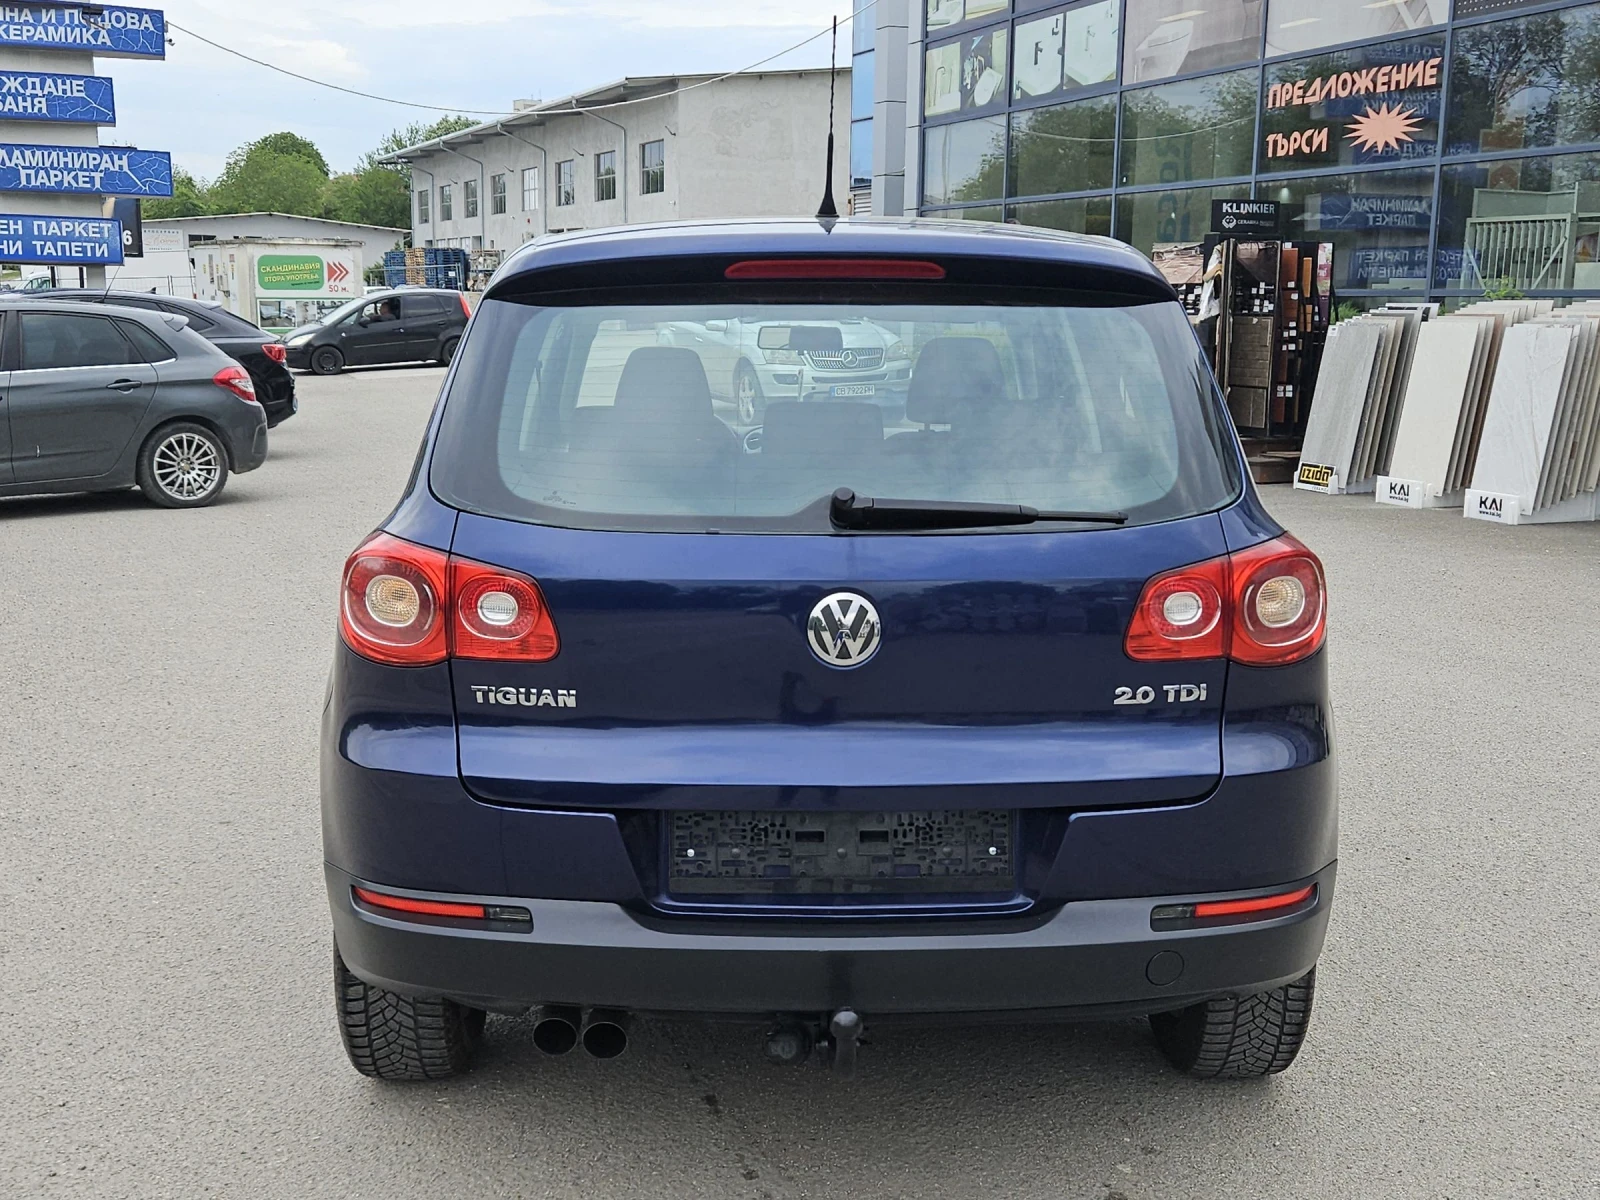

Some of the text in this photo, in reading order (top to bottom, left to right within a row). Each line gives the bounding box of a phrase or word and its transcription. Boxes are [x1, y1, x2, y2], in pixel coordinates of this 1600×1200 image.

[42, 9, 56, 23] И
[0, 76, 85, 97] ЖДАНЕ
[1268, 57, 1442, 109] ПРЕДЛОЖЕНИЕ
[0, 96, 47, 113] АНЯ
[1266, 127, 1328, 158] ТЪРСИ
[21, 170, 104, 188] ПАРКЕТ
[1222, 202, 1275, 214] KLINKIER
[33, 221, 112, 238] ПАРКЕТ
[123, 230, 133, 246] 6
[32, 241, 108, 258] ТАПЕТИ
[260, 262, 321, 273] СКАНДИНАВИЯ
[264, 275, 286, 283] ВТОРА
[328, 284, 339, 293] 50
[1389, 482, 1410, 496] KAI
[1479, 496, 1503, 512] KAI
[470, 685, 577, 708] TIGUAN
